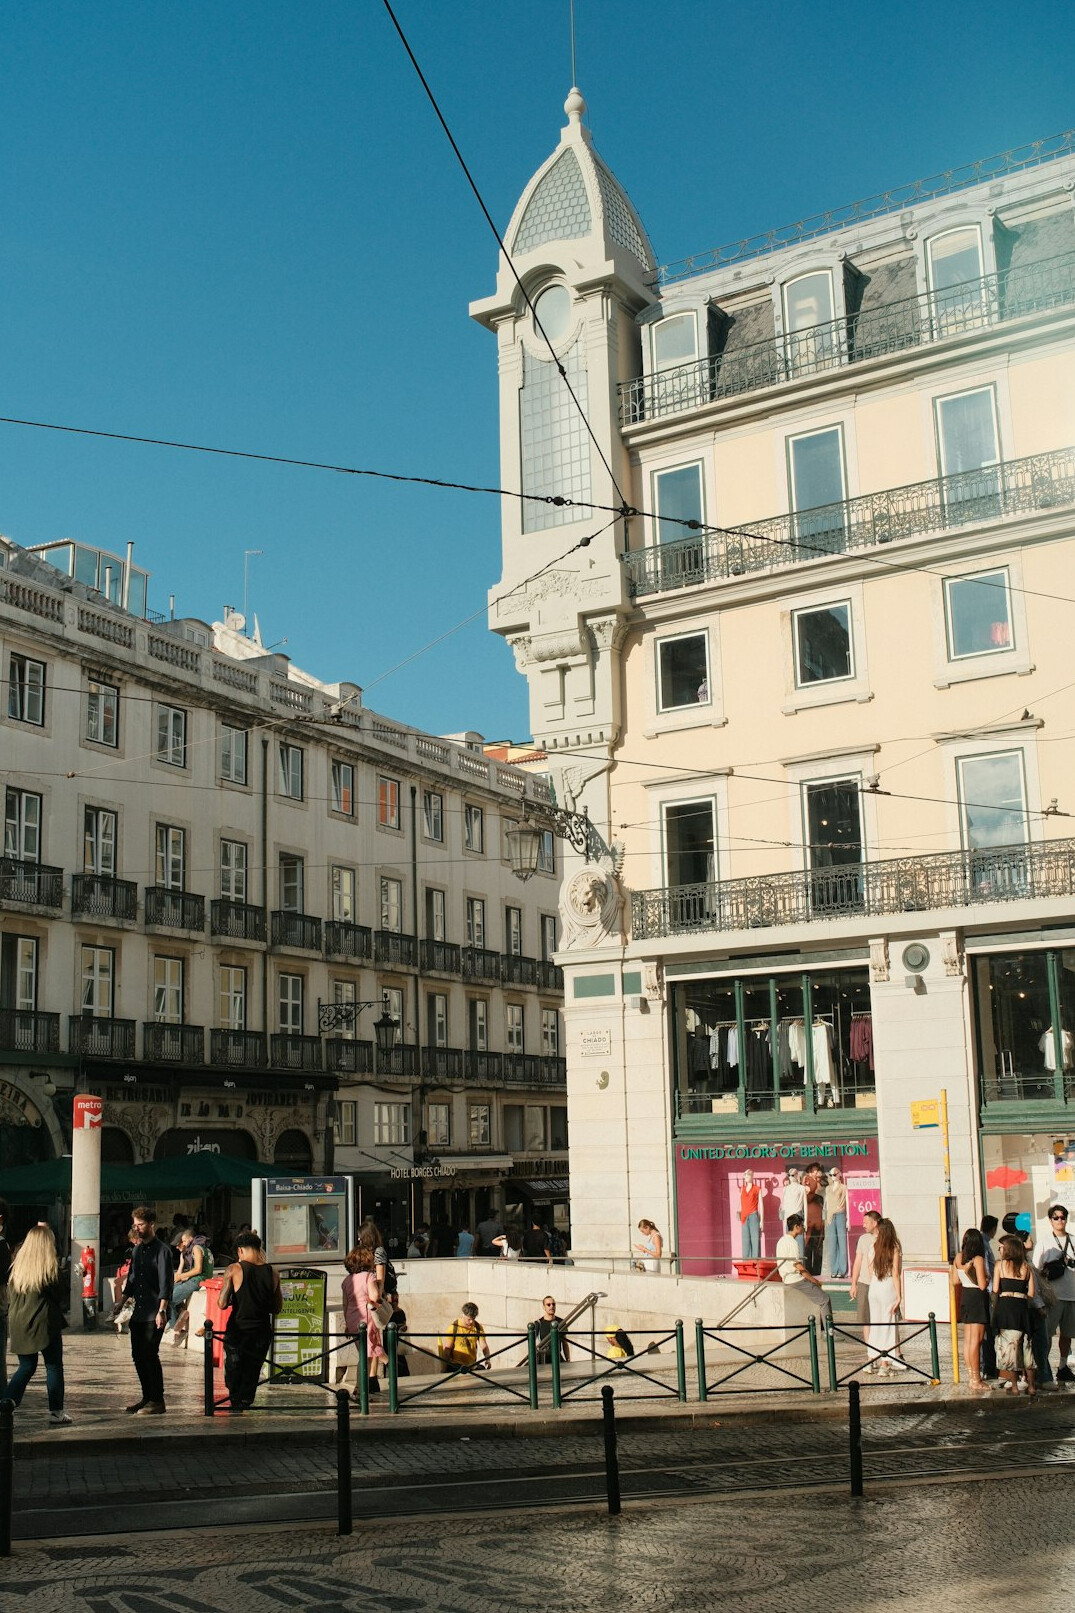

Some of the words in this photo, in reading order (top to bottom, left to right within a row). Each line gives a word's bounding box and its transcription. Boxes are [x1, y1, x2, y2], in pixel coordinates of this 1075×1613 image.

[78, 1101, 102, 1109] metro
[681, 1147, 725, 1160] UNITED
[728, 1146, 777, 1159] COLORS
[780, 1145, 797, 1157] OF
[391, 1168, 410, 1179] HOTEL
[411, 1166, 434, 1178] BORGES
[434, 1165, 456, 1177] CHIADO
[276, 1183, 313, 1191] Baixa-Chiado
